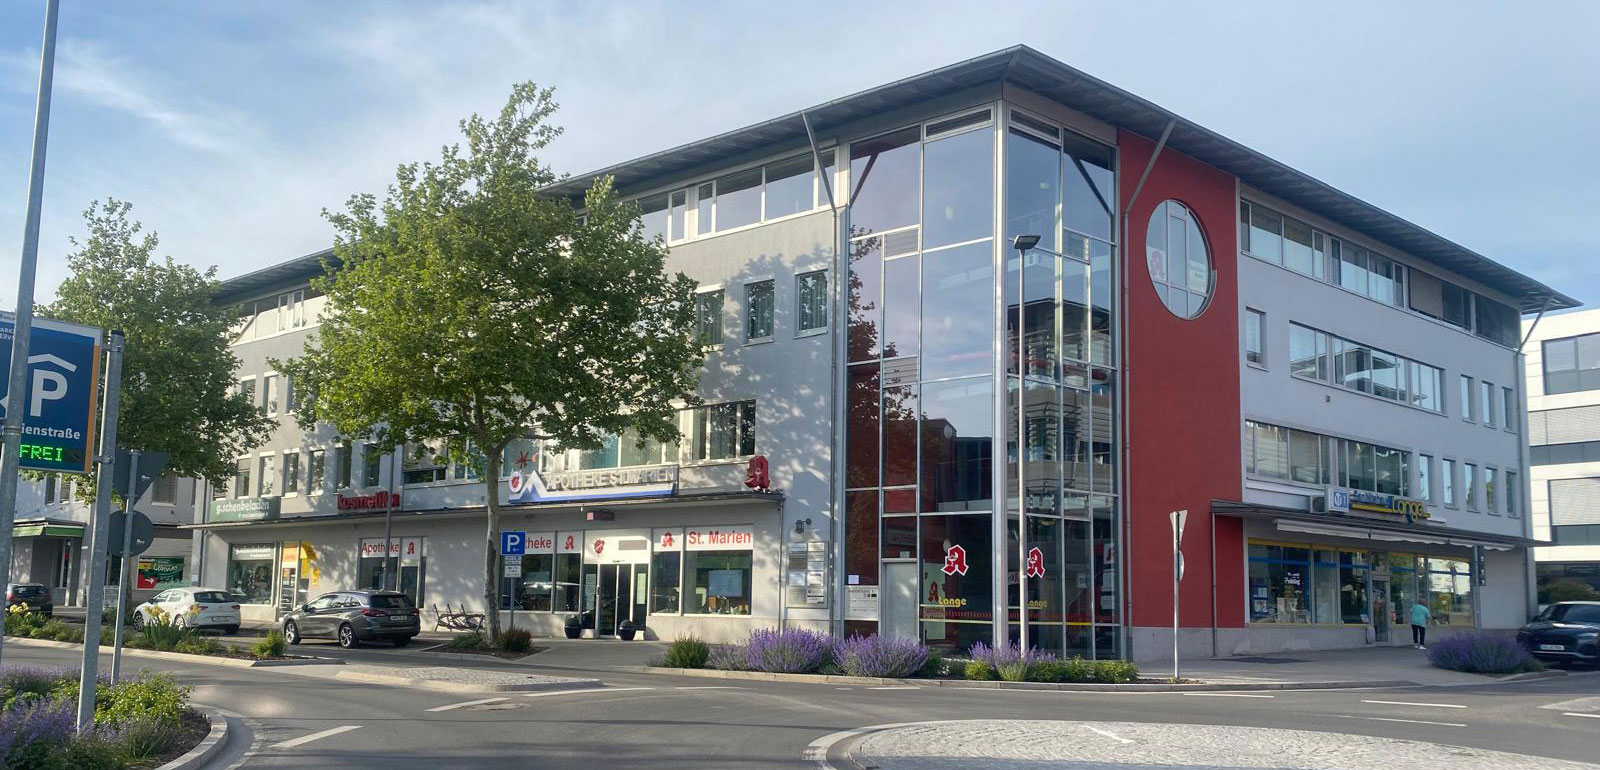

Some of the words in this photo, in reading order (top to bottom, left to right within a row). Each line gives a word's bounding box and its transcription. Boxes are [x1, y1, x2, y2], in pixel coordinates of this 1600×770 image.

[30, 369, 68, 417] P
[0, 422, 81, 440] ienstraße
[19, 444, 63, 462] FREI
[546, 470, 609, 491] APOTHEKE
[507, 534, 520, 553] P
[525, 536, 552, 549] theke
[688, 531, 705, 545] St.
[709, 530, 751, 545] Marien
[361, 542, 400, 555] Apothke
[939, 596, 967, 608] Lange
